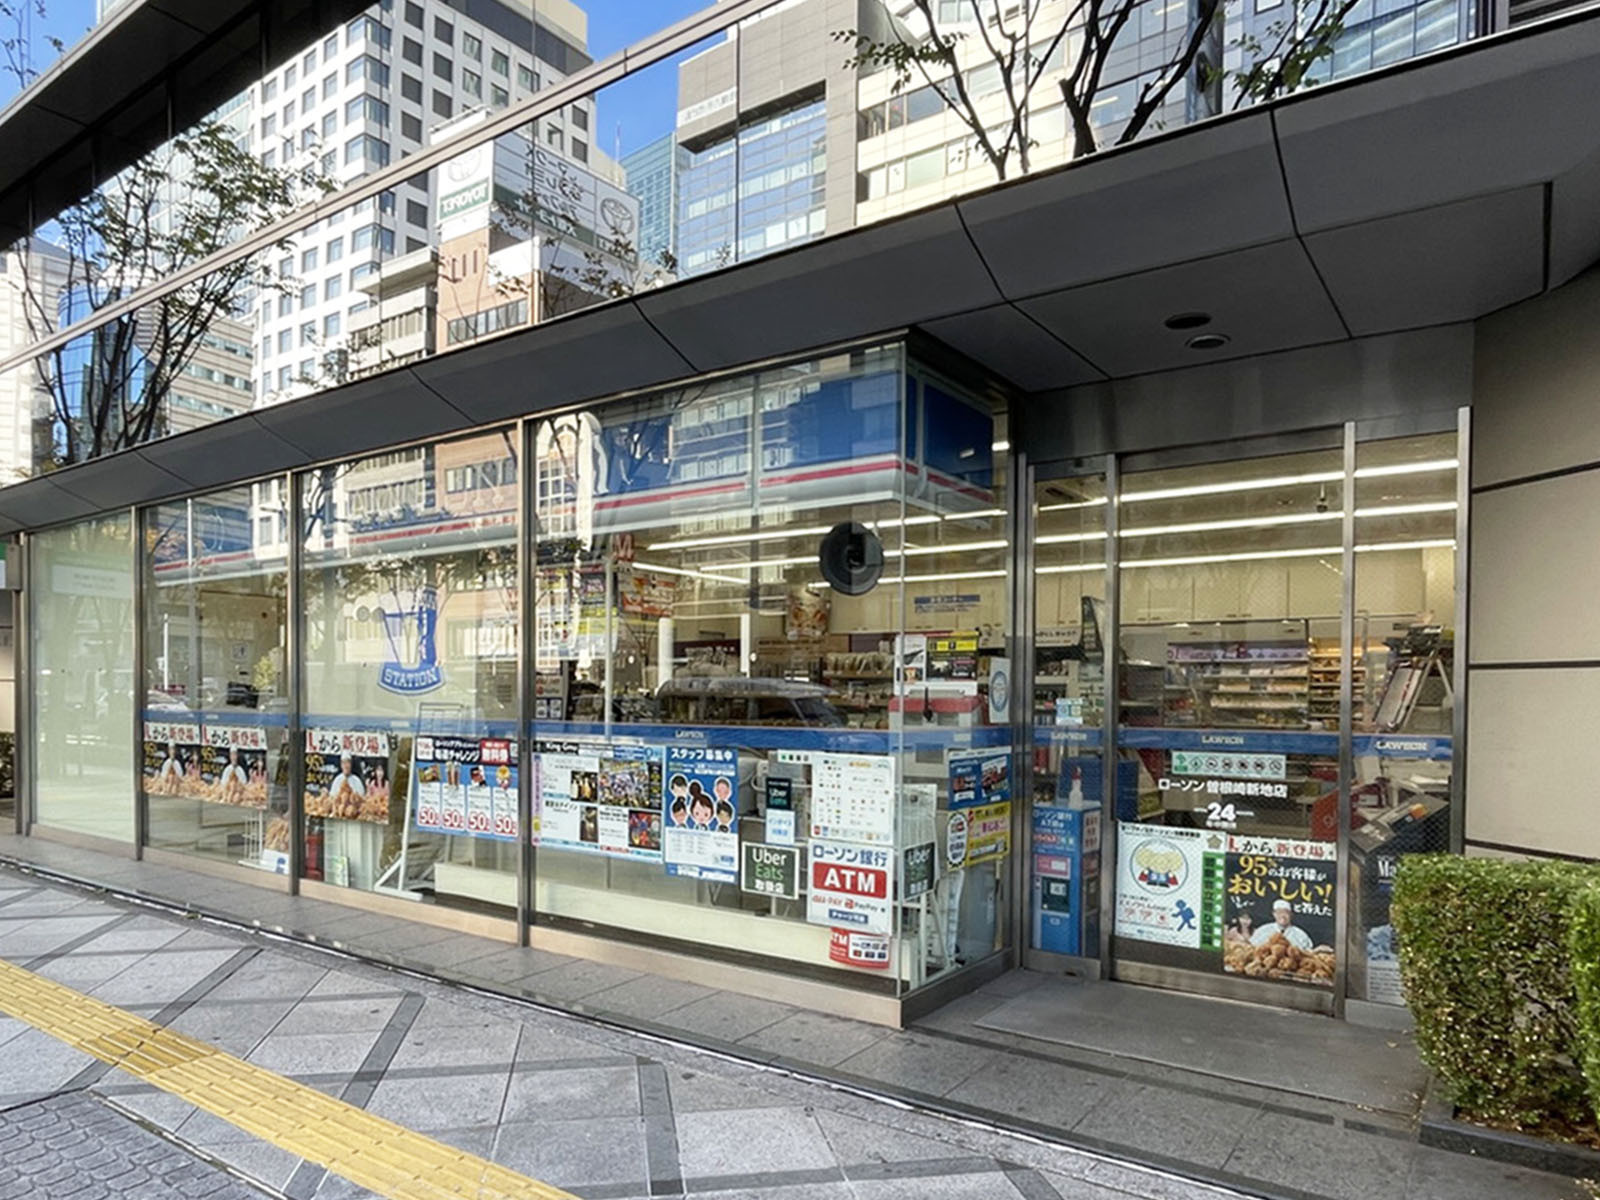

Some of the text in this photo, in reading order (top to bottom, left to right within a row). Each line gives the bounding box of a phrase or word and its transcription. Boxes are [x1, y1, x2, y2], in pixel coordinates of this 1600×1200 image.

[383, 666, 439, 688] STATION
[1158, 778, 1289, 799] ローソン 曽根崎新地店
[1207, 802, 1237, 821] 24
[752, 847, 787, 866] Uber
[813, 845, 888, 867] ローソン銀行
[754, 864, 785, 881] Eats
[823, 868, 876, 894] ATM
[1228, 874, 1334, 904] おいしい!
